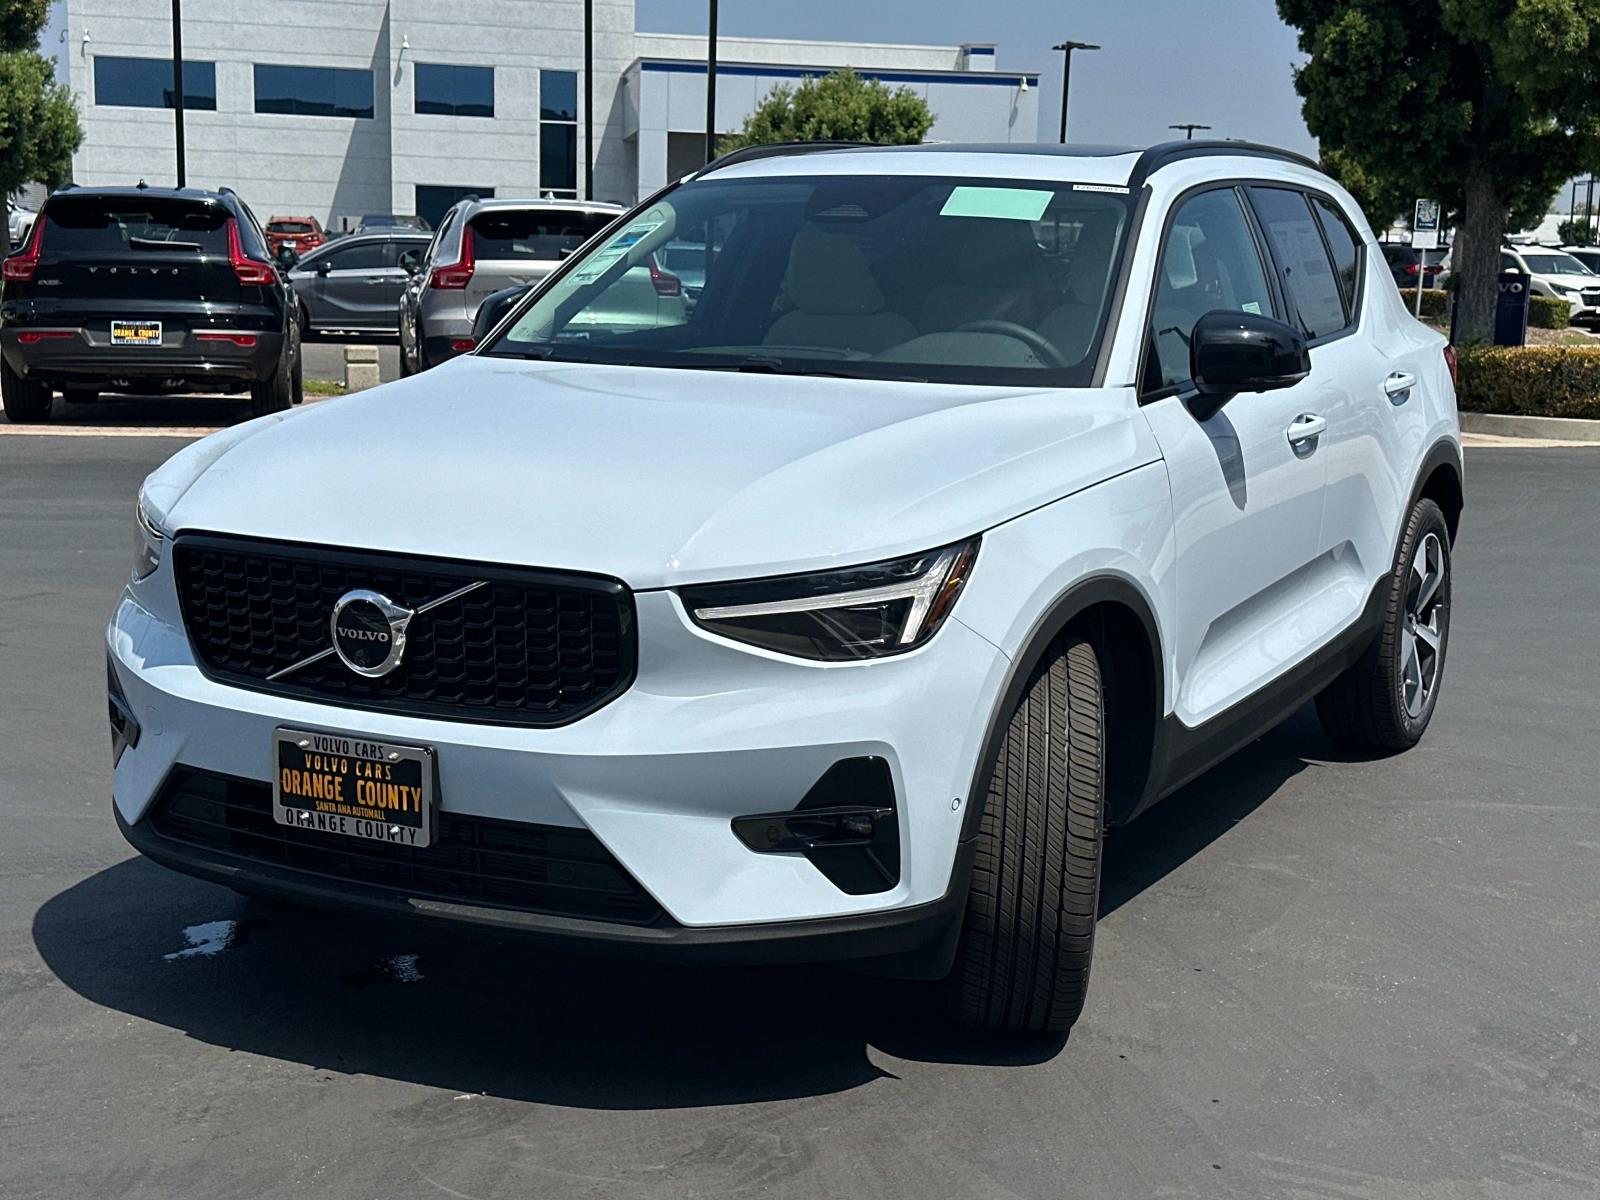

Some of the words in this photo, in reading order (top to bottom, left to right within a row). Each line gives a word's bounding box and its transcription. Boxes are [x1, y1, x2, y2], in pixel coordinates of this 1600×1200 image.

[89, 267, 180, 275] VOLVO
[337, 626, 389, 643] VOLVO
[314, 736, 349, 755] VOLVO
[355, 743, 384, 760] CARS
[305, 753, 348, 774] VOLVO
[355, 761, 391, 780] CARS
[282, 768, 344, 802] ORANGE
[356, 780, 422, 813] COUNTY
[315, 800, 336, 814] SANTA
[337, 804, 351, 815] ANA
[352, 806, 386, 821] AUTOMALL
[286, 808, 347, 833] ORANGE
[356, 820, 416, 844] COUNTY
